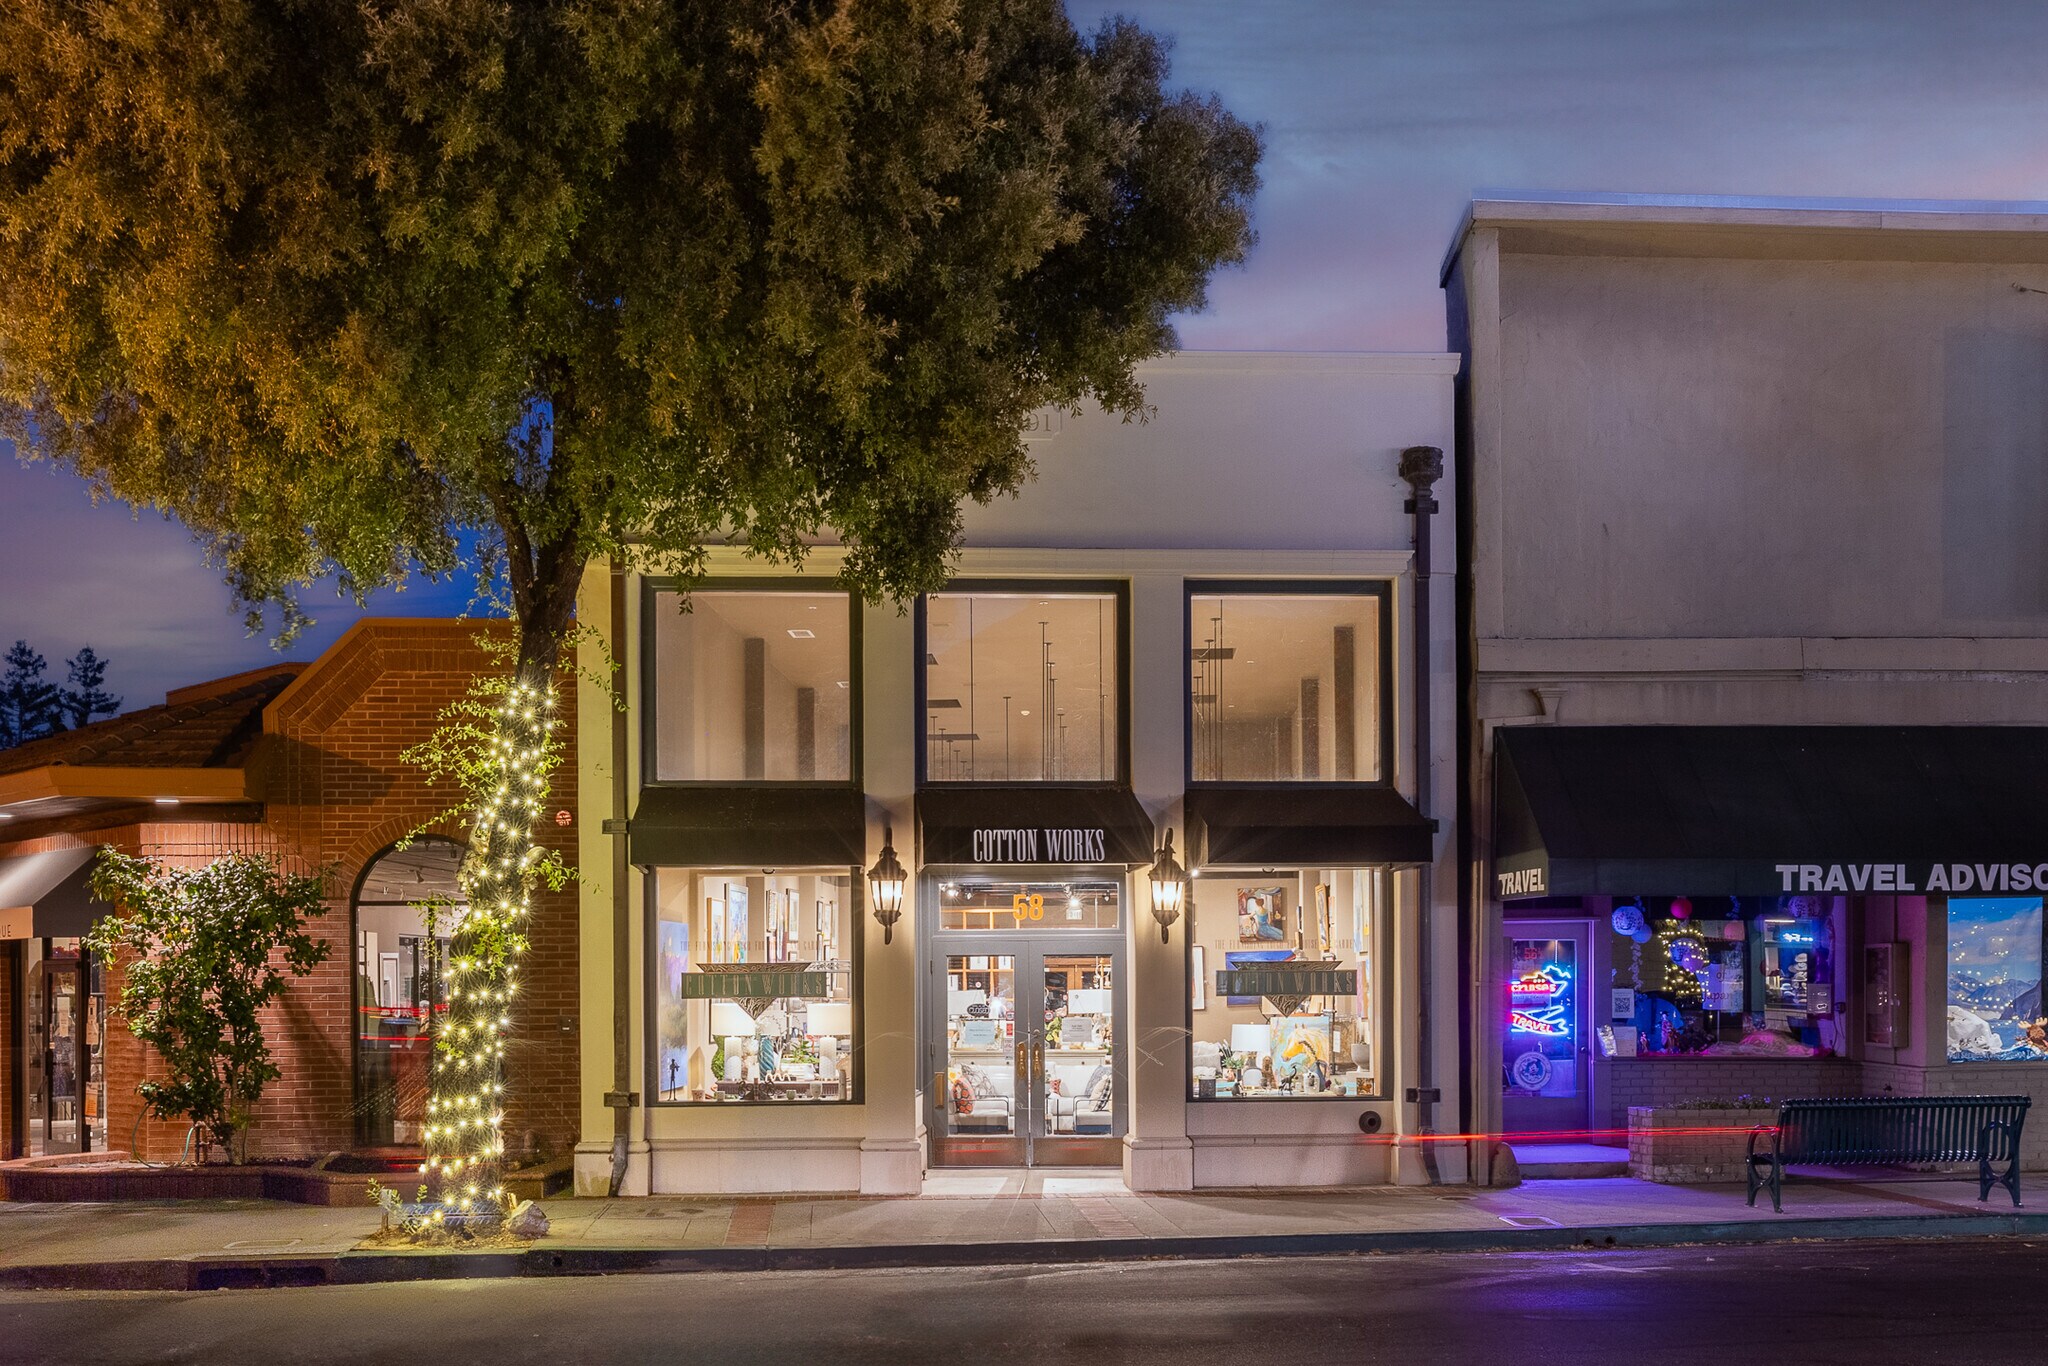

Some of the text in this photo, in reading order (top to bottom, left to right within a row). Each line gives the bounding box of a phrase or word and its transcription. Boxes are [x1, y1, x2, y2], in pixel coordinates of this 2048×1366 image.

[973, 828, 1106, 863] COTTON WORKS
[1498, 868, 1545, 896] TRAVEL
[1776, 862, 2048, 892] TRAVEL ADVISO
[1012, 893, 1044, 921] 58
[685, 974, 822, 995] COTTON WORKS
[1222, 971, 1353, 993] OTTON WORKS
[1512, 1014, 1553, 1034] TRAVEL
